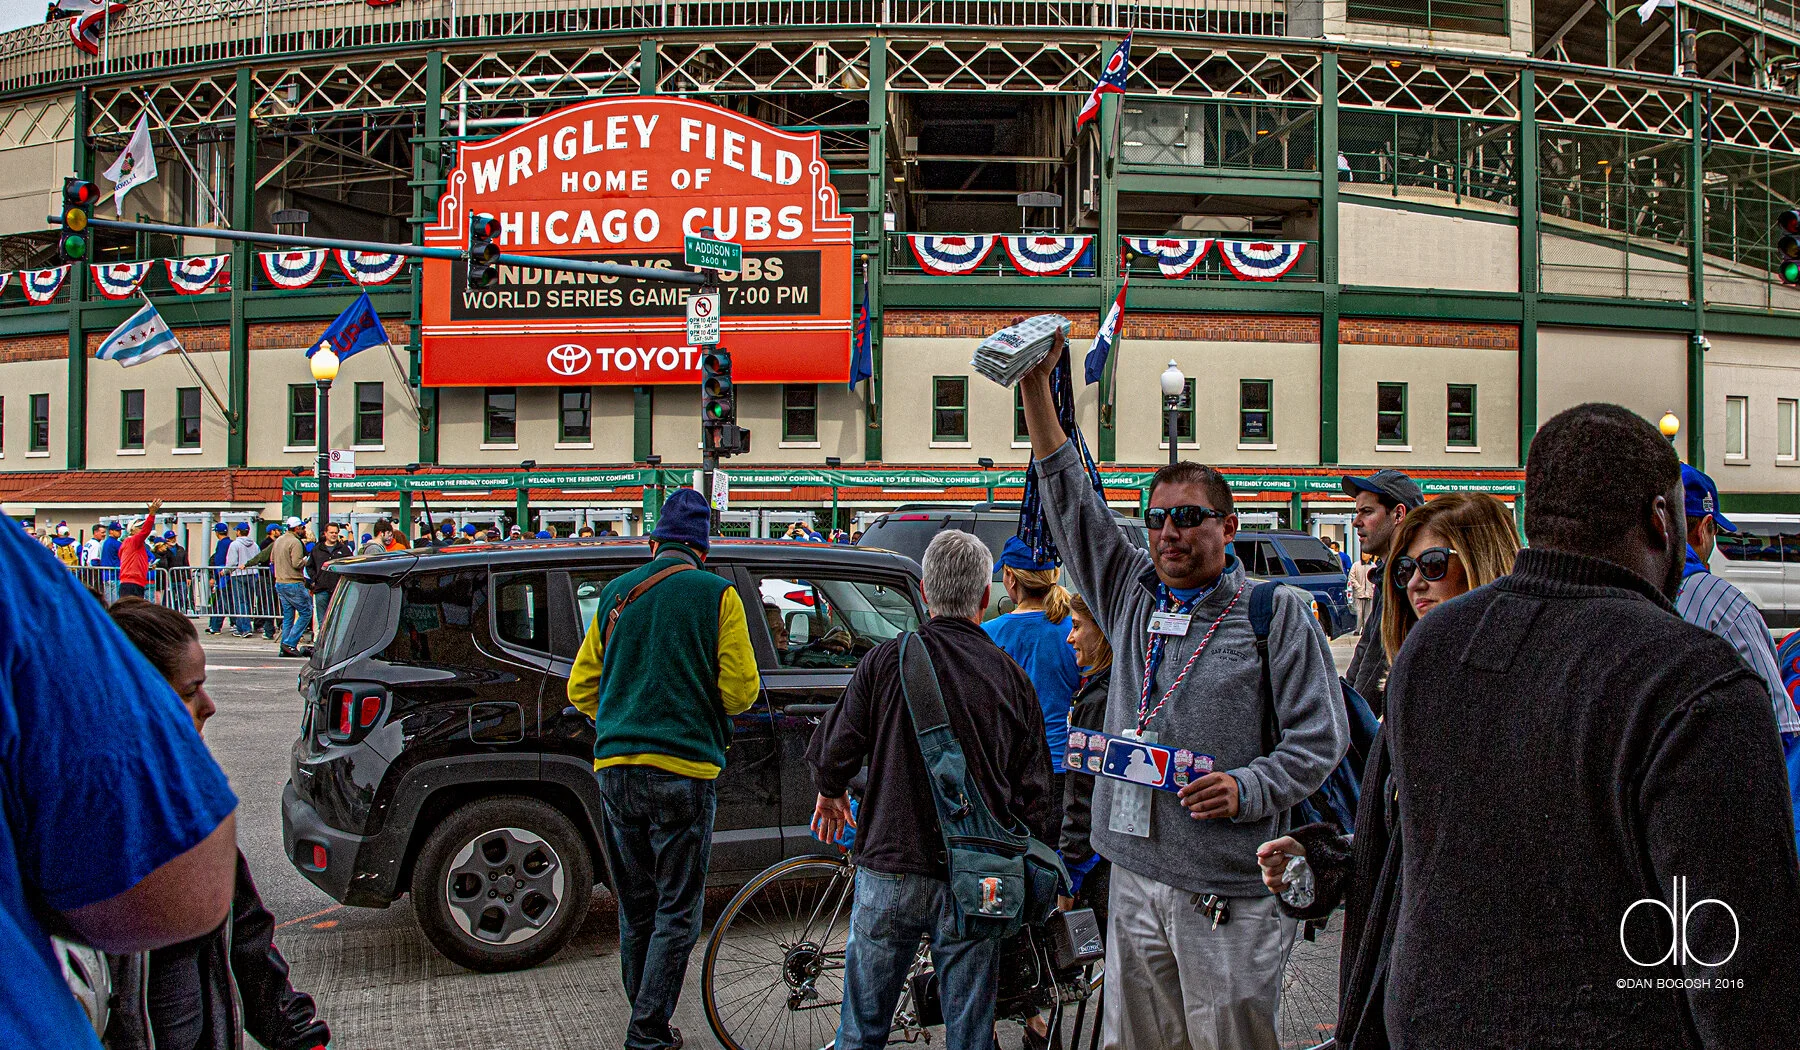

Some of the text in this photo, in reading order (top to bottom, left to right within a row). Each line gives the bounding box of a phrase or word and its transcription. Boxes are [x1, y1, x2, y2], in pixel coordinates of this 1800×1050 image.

[471, 114, 803, 195] WRIGLEY FIELD
[561, 168, 712, 193] HOME OF
[475, 205, 804, 246] HICAGO CUBS
[695, 241, 730, 258] ADDISON
[701, 255, 719, 265] 3600
[463, 286, 808, 309] WORLD SERIES GAME 7:00 PM
[577, 475, 605, 483] FRIENDLY
